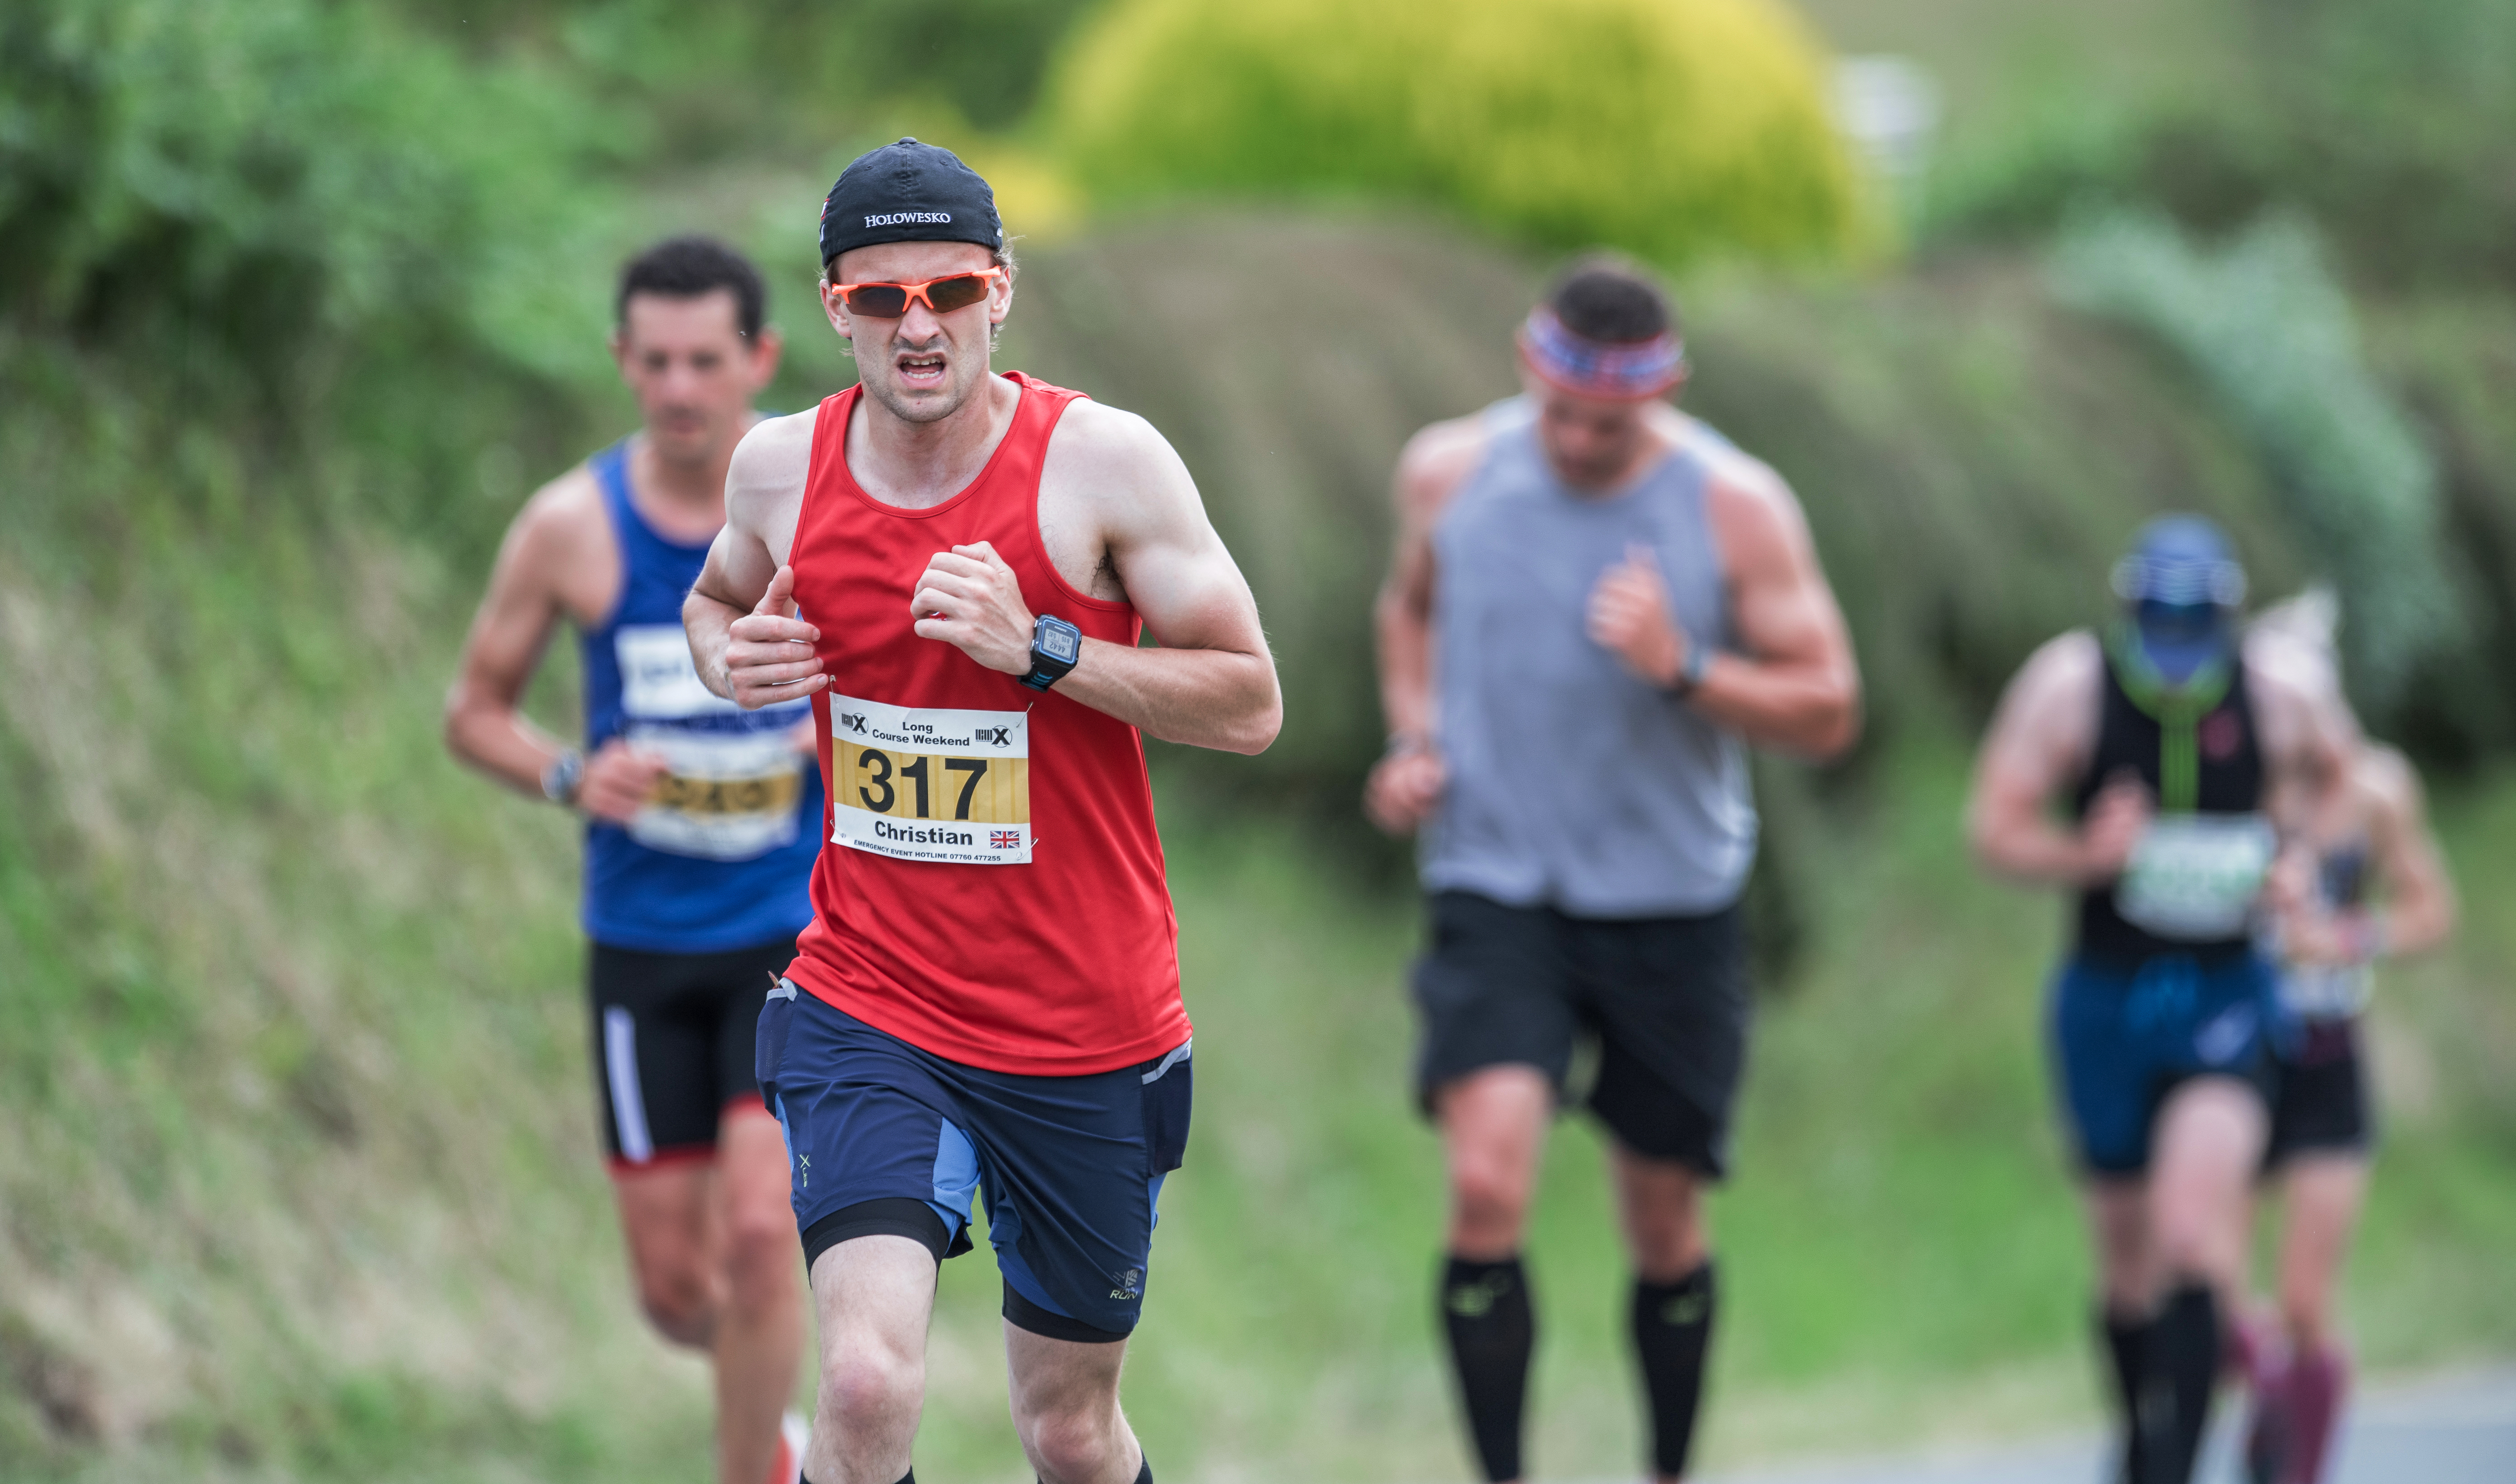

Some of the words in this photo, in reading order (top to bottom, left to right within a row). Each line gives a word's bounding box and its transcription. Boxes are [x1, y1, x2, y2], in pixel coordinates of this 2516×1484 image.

[864, 212, 951, 228] HOLOWESKO
[902, 721, 933, 734] Long
[872, 729, 910, 743] Course
[912, 734, 970, 746] Weekend
[859, 749, 987, 820] 317
[874, 820, 973, 846] Christian
[854, 839, 889, 853] EMERGENCY
[891, 848, 913, 857] EVENT
[915, 851, 948, 859] HOTLINE
[1110, 1290, 1138, 1300] RUN
